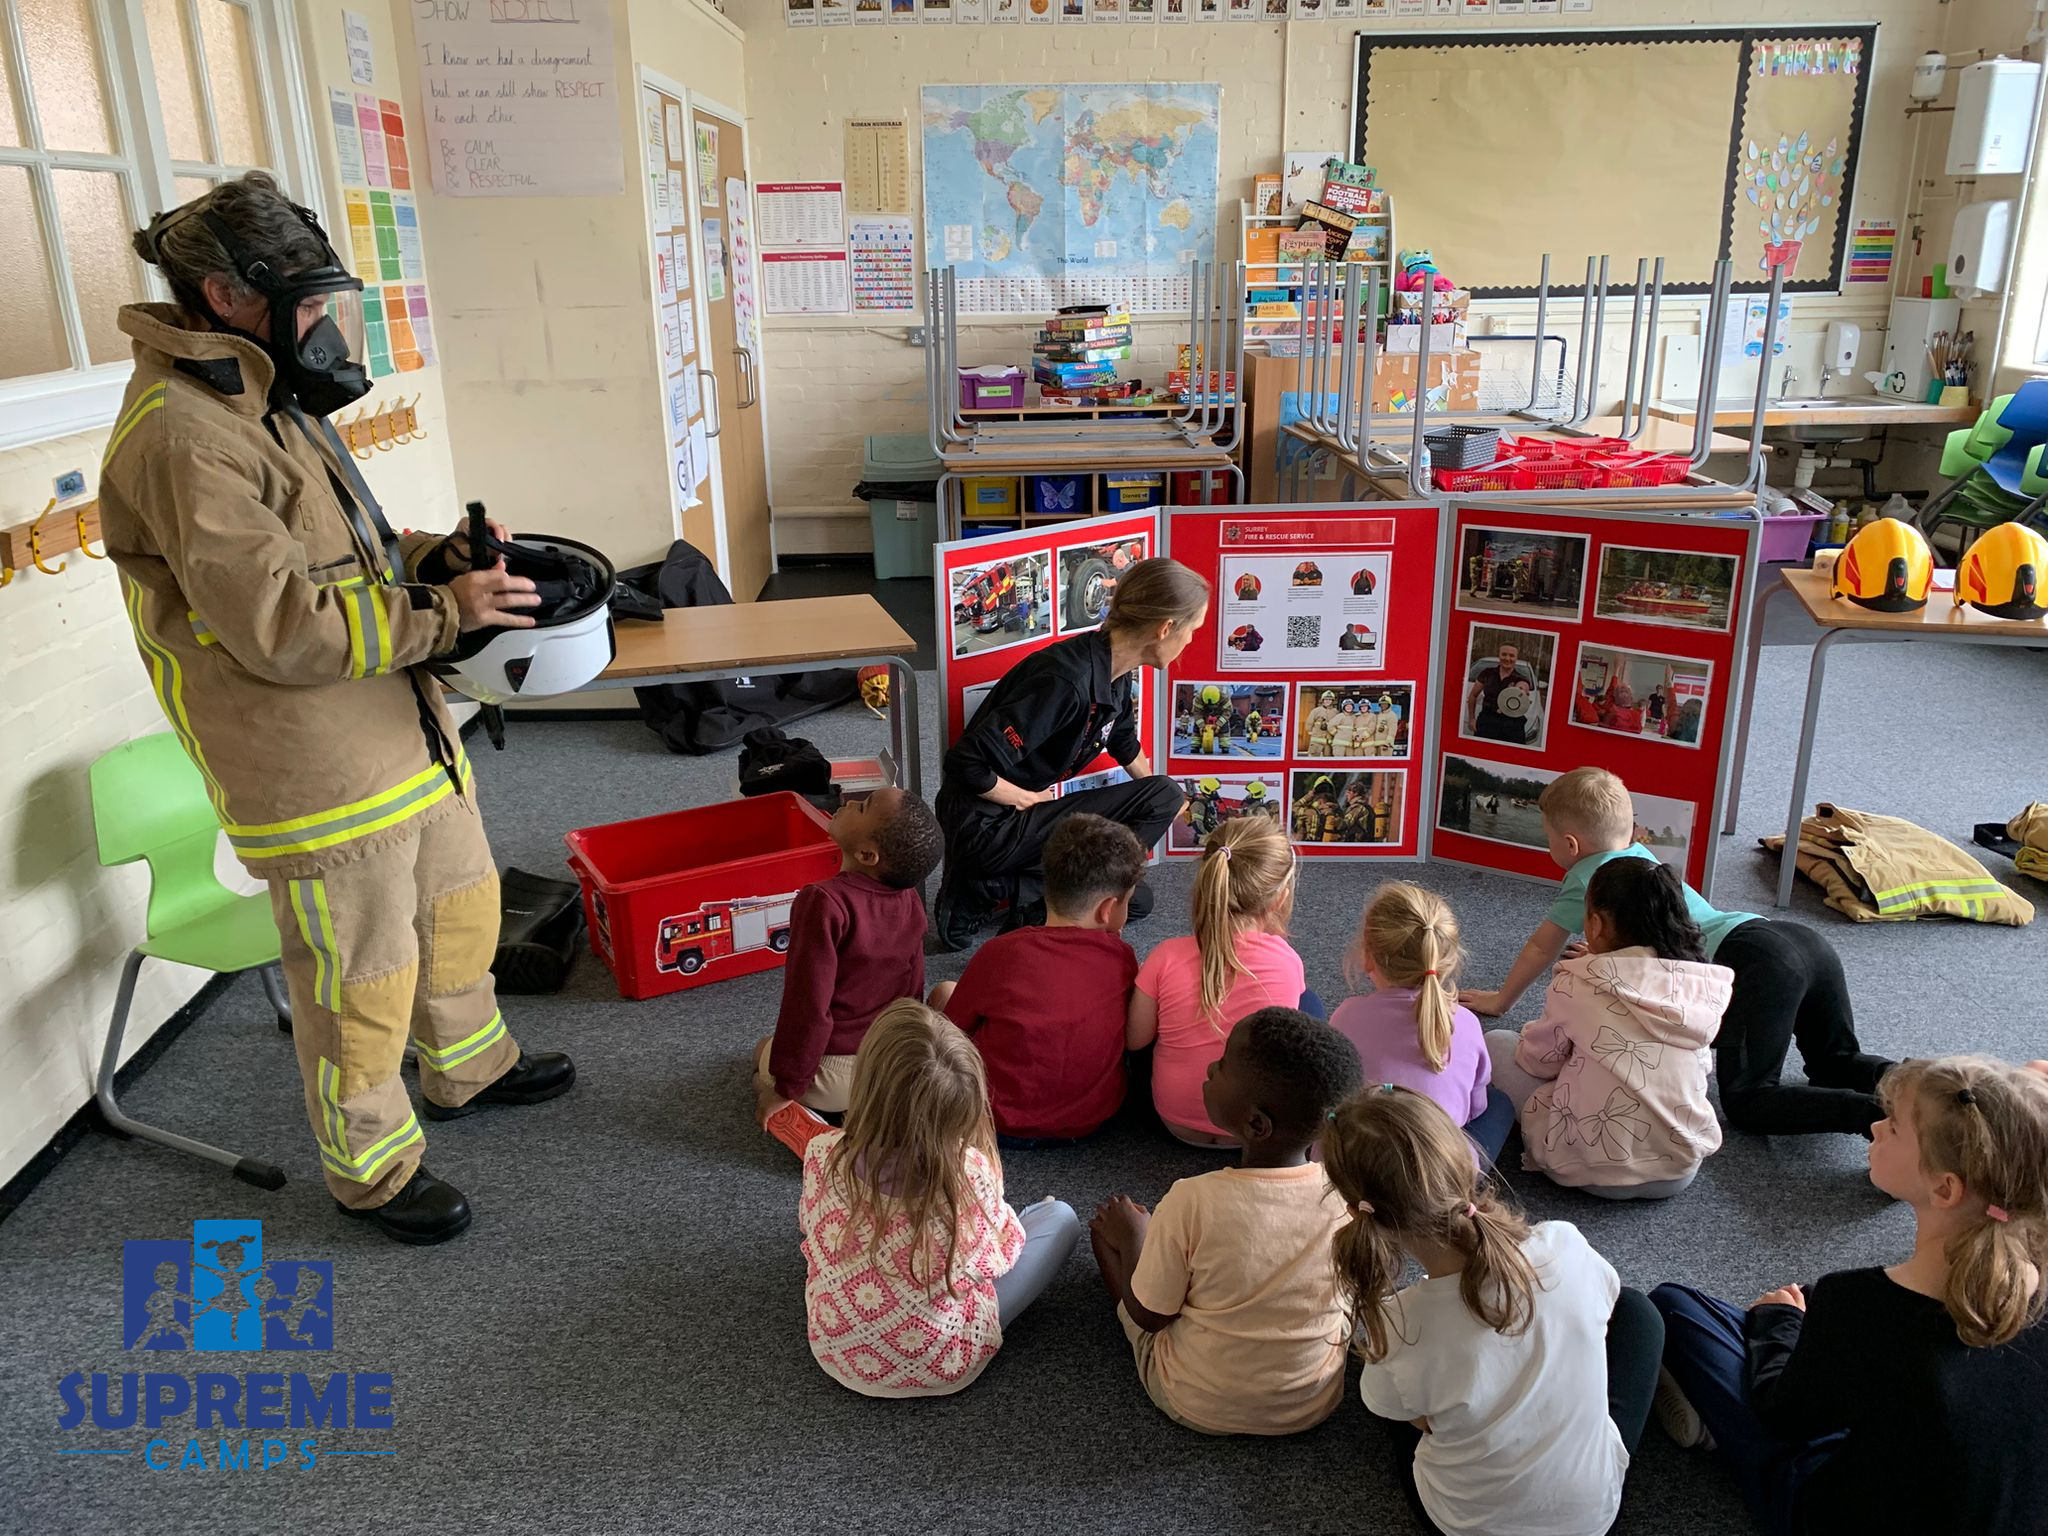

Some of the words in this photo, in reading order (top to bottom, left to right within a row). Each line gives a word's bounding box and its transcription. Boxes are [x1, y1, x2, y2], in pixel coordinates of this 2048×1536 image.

[412, 0, 469, 21] SHOW
[422, 43, 432, 66] I
[443, 44, 469, 66] know
[476, 55, 490, 66] we
[498, 48, 513, 66] had
[531, 48, 592, 72] disagreement
[1755, 42, 1863, 77] THRIVE
[431, 80, 450, 98] but
[457, 88, 471, 98] we
[475, 88, 490, 98] can
[495, 80, 516, 98] still
[522, 82, 550, 98] show
[555, 80, 605, 99] RESPECT
[434, 105, 446, 124] to
[454, 105, 478, 124] each
[1326, 194, 1367, 207] RECORDS
[1327, 188, 1368, 200] FOOTBALL
[1861, 219, 1891, 228] Respect
[1056, 256, 1068, 264] The
[1070, 256, 1089, 264] World
[1003, 725, 1024, 750] FIRE
